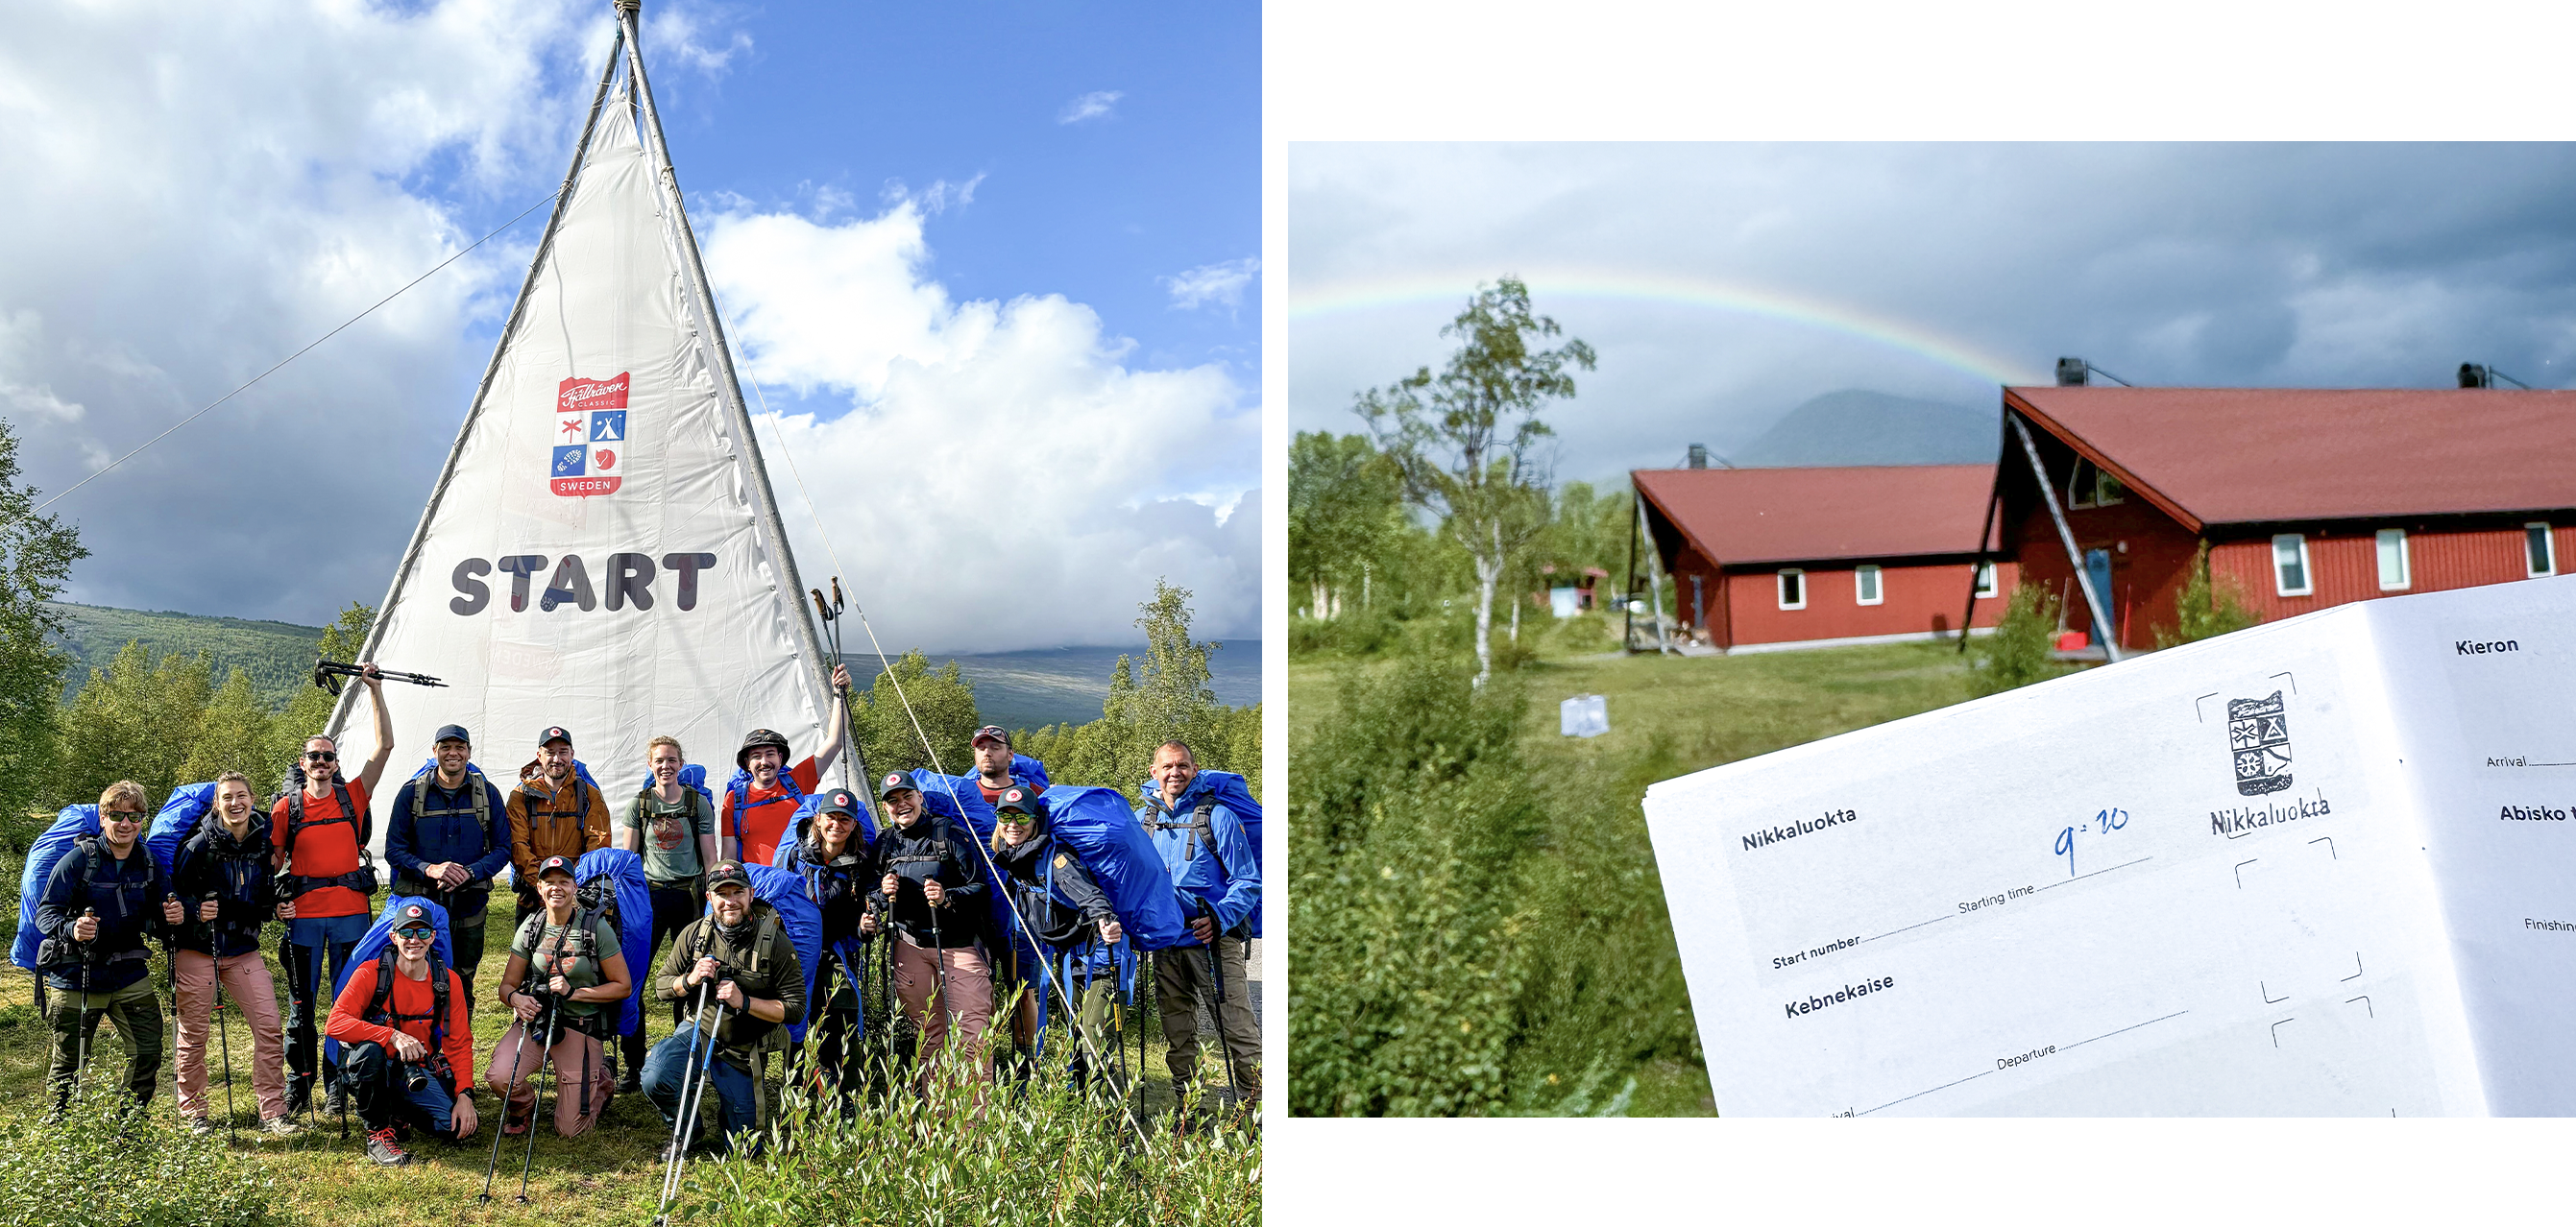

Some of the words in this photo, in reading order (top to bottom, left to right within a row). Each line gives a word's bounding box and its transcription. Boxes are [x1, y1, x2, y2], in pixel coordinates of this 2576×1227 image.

[560, 382, 627, 409] Fjällräven
[560, 481, 611, 492] SWEDEN
[450, 554, 717, 615] START
[2455, 638, 2519, 657] Kieron
[2486, 754, 2528, 768] Arrival
[2499, 805, 2566, 822] Abisko
[1741, 808, 1857, 852] Nikkaluokta
[1957, 894, 2005, 915] Starting
[2007, 885, 2034, 902] time
[2524, 918, 2576, 933] Finishin
[1772, 949, 1808, 970] Start
[1810, 934, 1860, 959] number
[1785, 974, 1894, 1020] Kebnekaise
[1996, 1044, 2056, 1072] Departure
